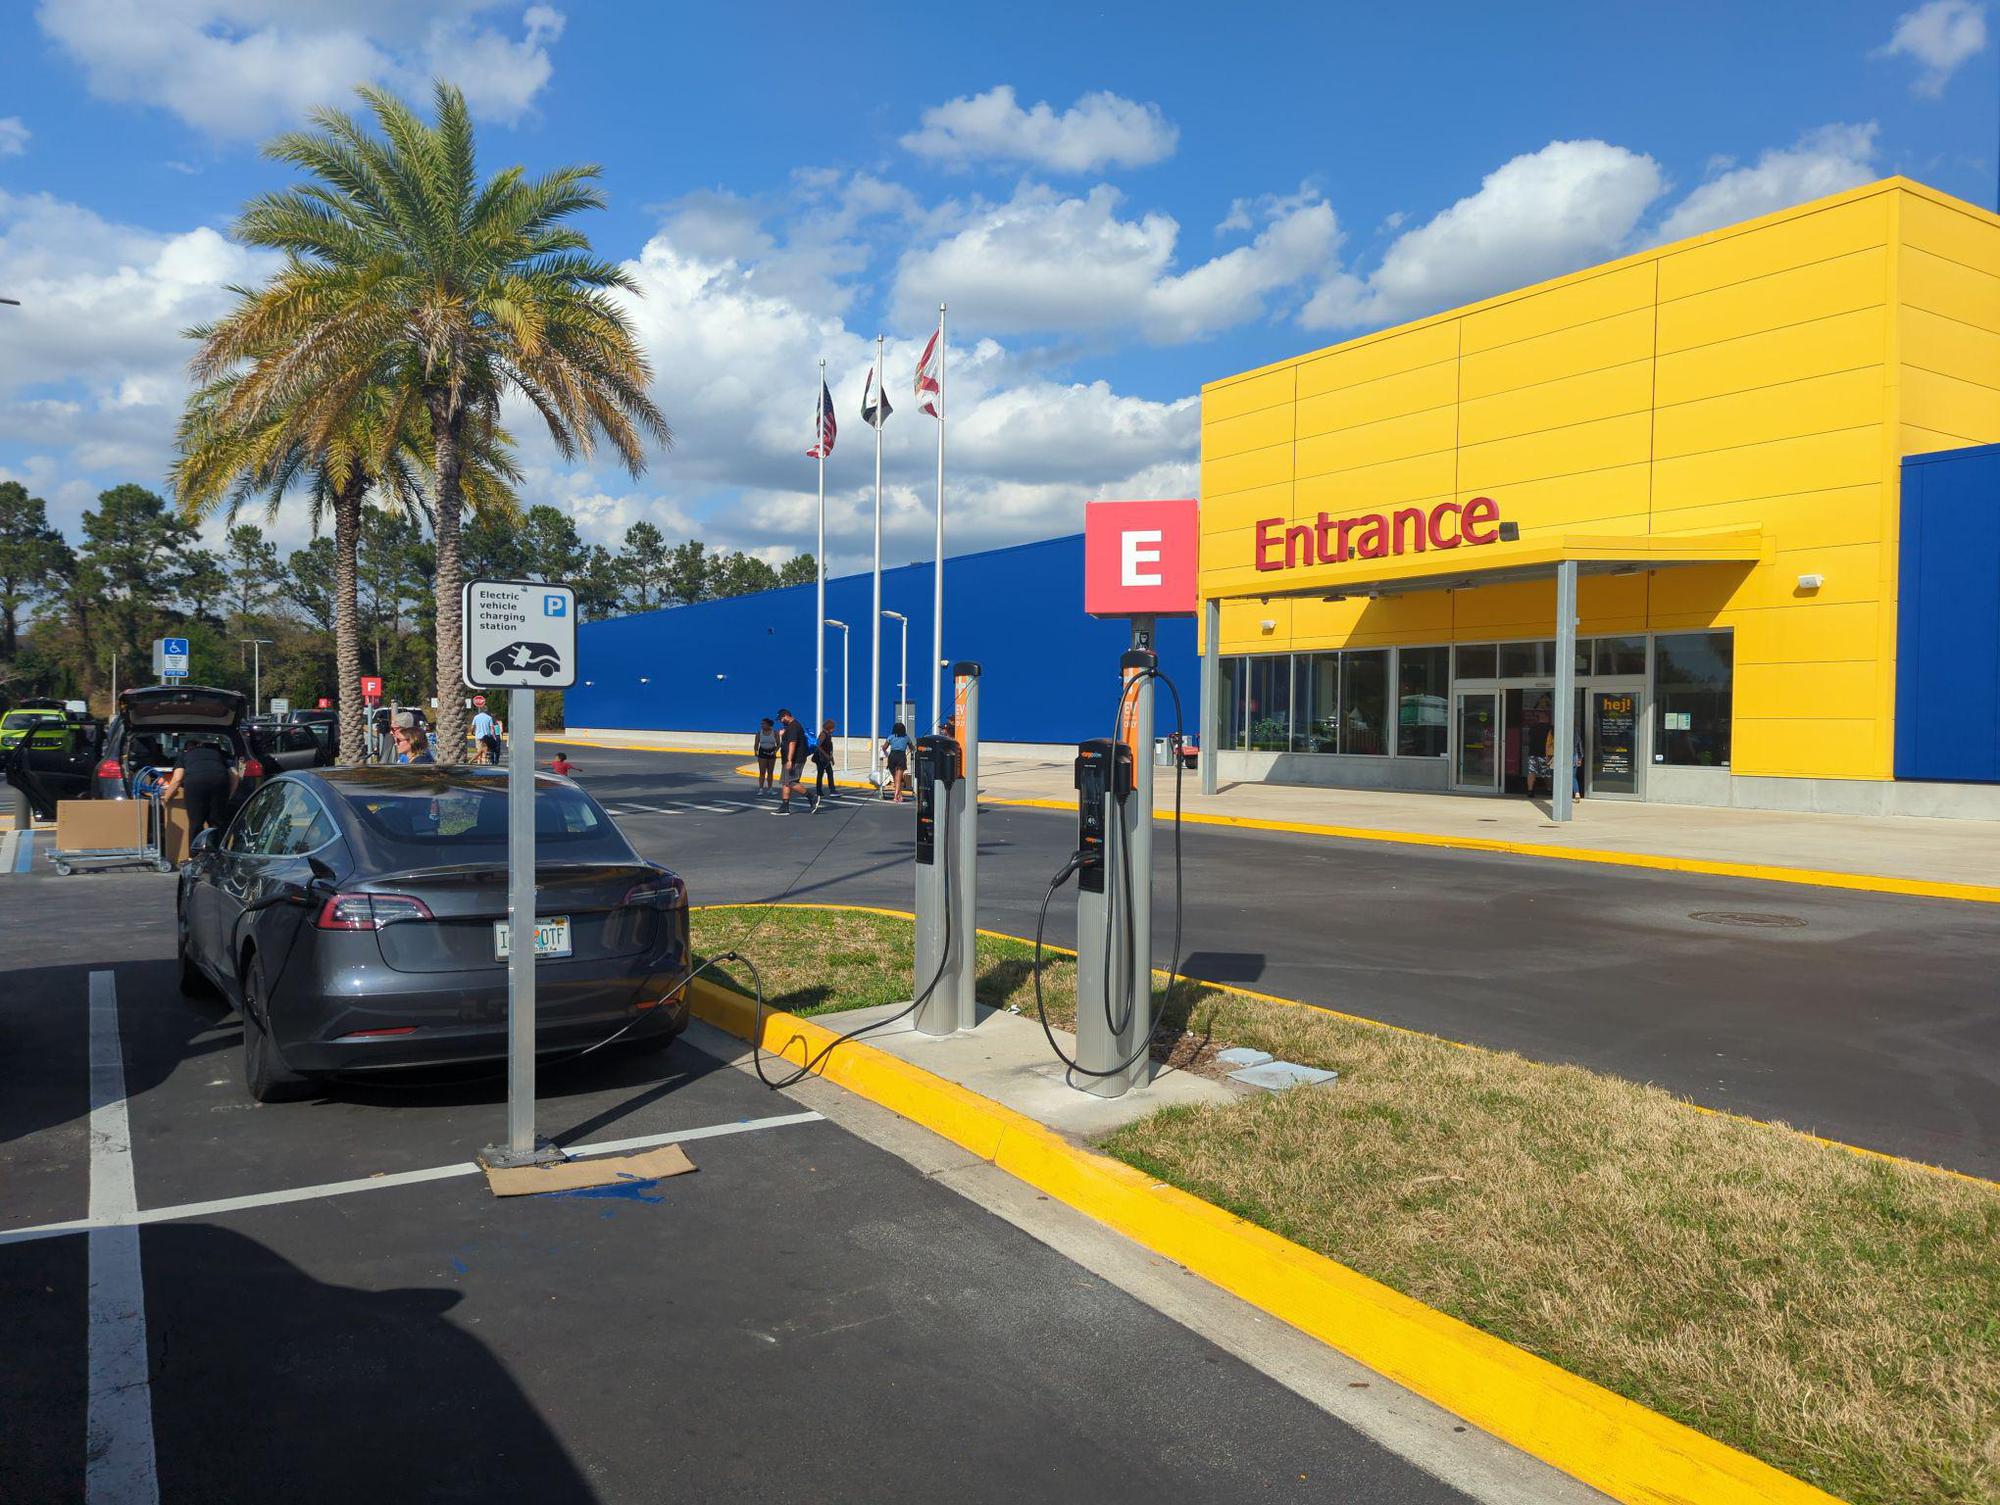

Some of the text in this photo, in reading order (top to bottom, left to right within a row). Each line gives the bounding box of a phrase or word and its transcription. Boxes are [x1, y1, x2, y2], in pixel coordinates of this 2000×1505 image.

[1255, 496, 1500, 571] Entrance
[1121, 530, 1162, 587] E
[480, 591, 519, 601] Electric
[480, 602, 517, 611] vehicle
[547, 597, 563, 615] P
[480, 612, 526, 622] charging
[480, 622, 517, 631] station
[367, 682, 376, 691] F
[1603, 698, 1631, 712] hej!
